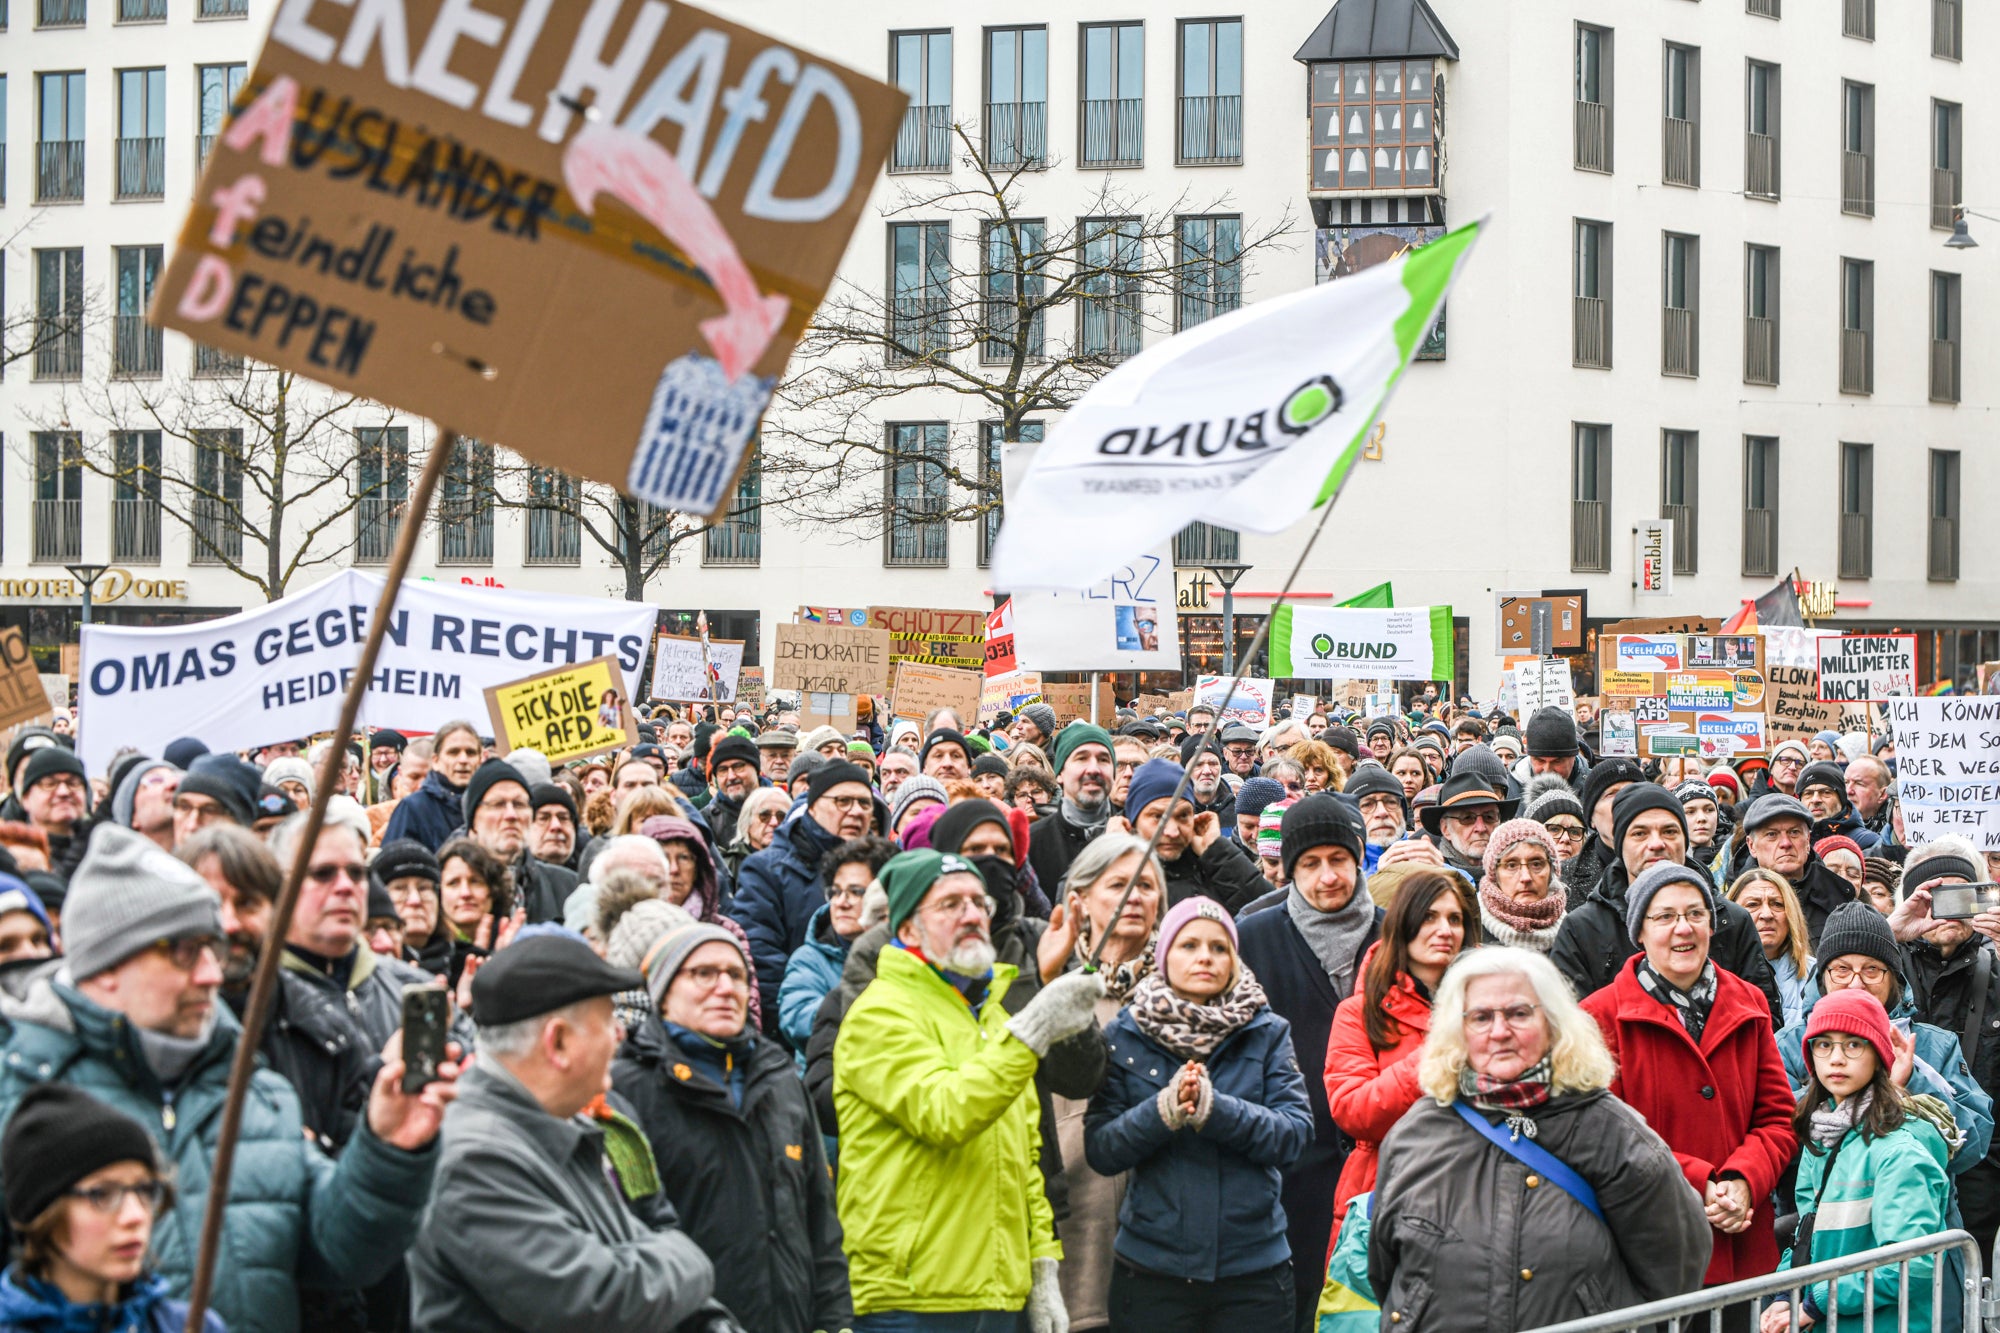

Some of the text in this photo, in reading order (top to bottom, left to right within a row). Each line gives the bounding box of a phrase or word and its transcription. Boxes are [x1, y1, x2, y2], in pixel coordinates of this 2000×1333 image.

[210, 174, 499, 326] feindliche
[177, 254, 376, 377] DEPPEN
[1644, 525, 1662, 591] extrablatt
[873, 608, 982, 636] SCHÜTZT
[89, 640, 236, 697] OMAS
[431, 613, 643, 672] RECHTS
[776, 640, 881, 665] DEMOKRATIE
[896, 640, 959, 657] UNSERE
[1336, 642, 1398, 659] BUND
[1621, 644, 1676, 656] EKELHAfD
[1841, 637, 1900, 657] KEINEN
[1821, 654, 1910, 675] MILLIMETER
[1769, 667, 1808, 686] ELON
[1670, 685, 1725, 696] MILLIMETER
[1822, 679, 1870, 701] NACH
[513, 680, 597, 731] FICK DIE
[1636, 697, 1668, 709] FCK
[1670, 695, 1730, 708] NACH RECHTS
[1893, 701, 1919, 722] ICH
[1636, 708, 1669, 721] AFD
[545, 714, 593, 748] AFD
[1701, 722, 1757, 735] EKELHAfD
[1896, 730, 1920, 749] AUF
[1927, 731, 1967, 750] DEM
[1899, 755, 1947, 777] ABER
[1907, 808, 1989, 825] ICH JETZT
